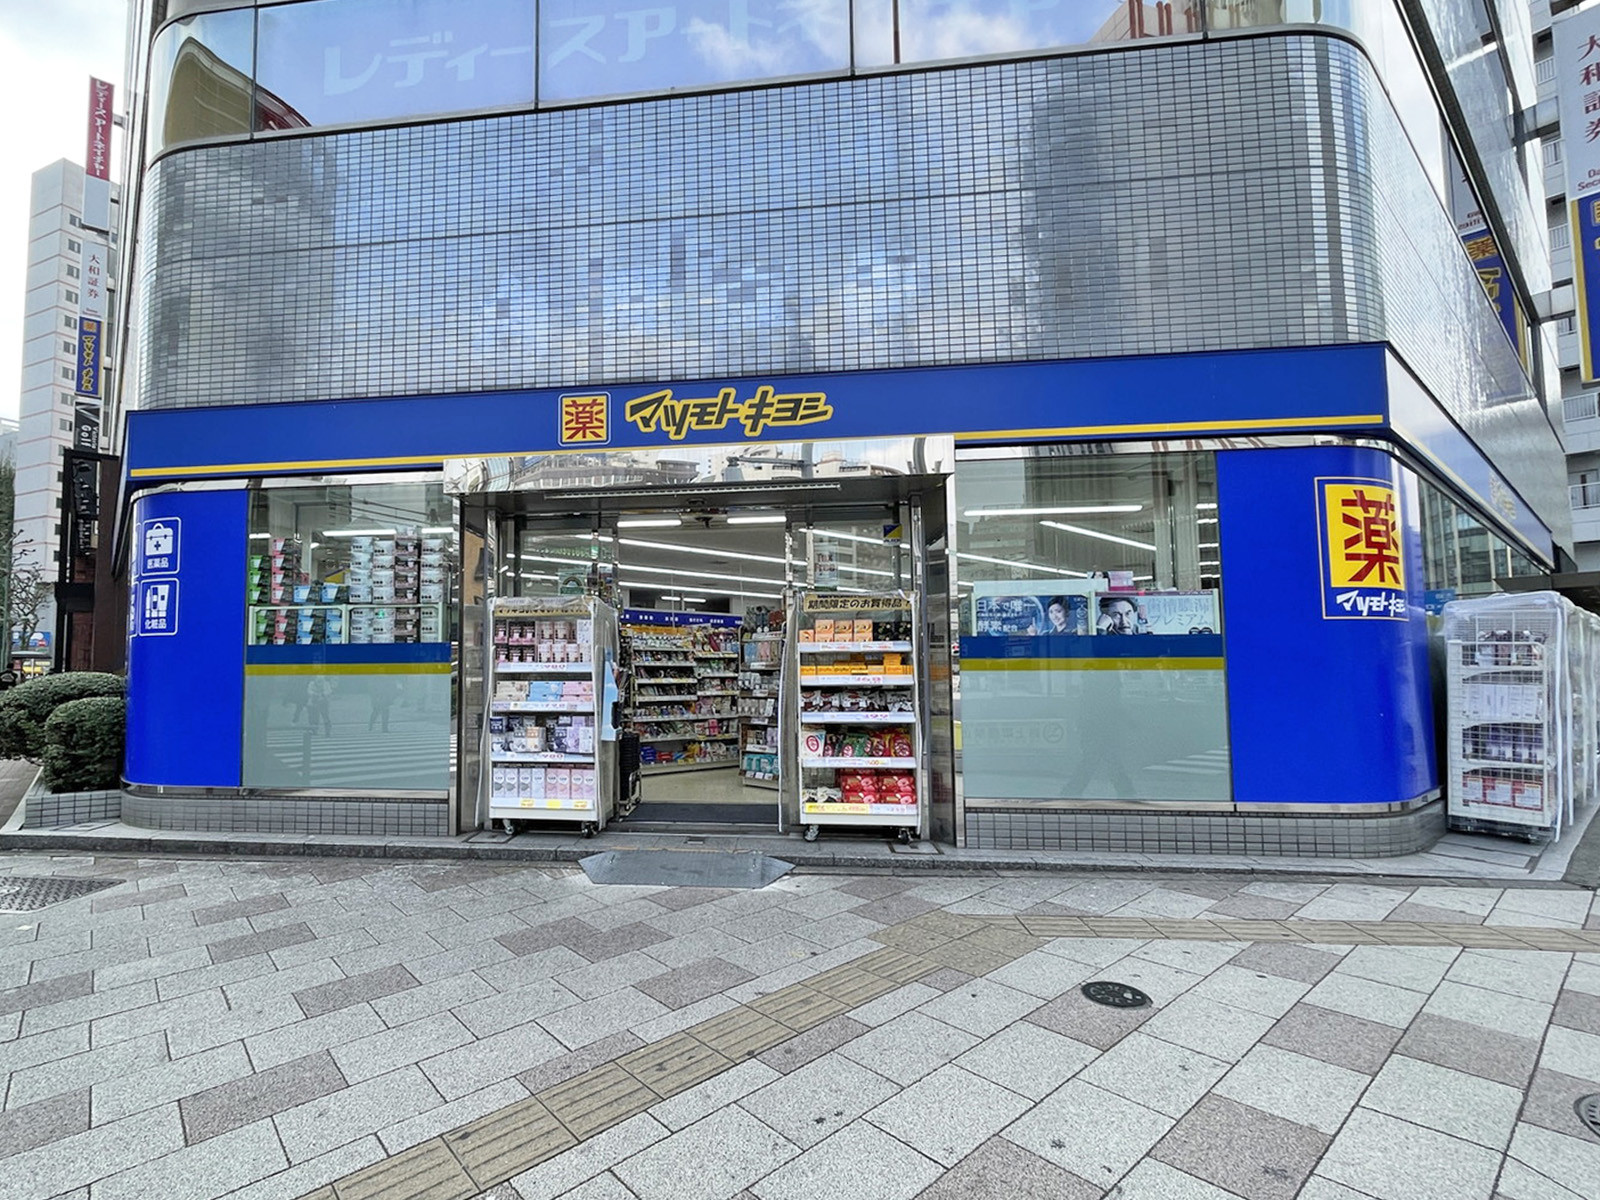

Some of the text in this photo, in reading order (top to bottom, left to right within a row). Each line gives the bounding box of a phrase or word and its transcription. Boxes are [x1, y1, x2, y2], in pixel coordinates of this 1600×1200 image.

[564, 385, 834, 440] 薬 マツモトキヨシ
[80, 424, 92, 448] Golf
[1341, 489, 1401, 585] 薬
[144, 618, 167, 630] 化粧品
[1149, 614, 1208, 627] プレミアム
